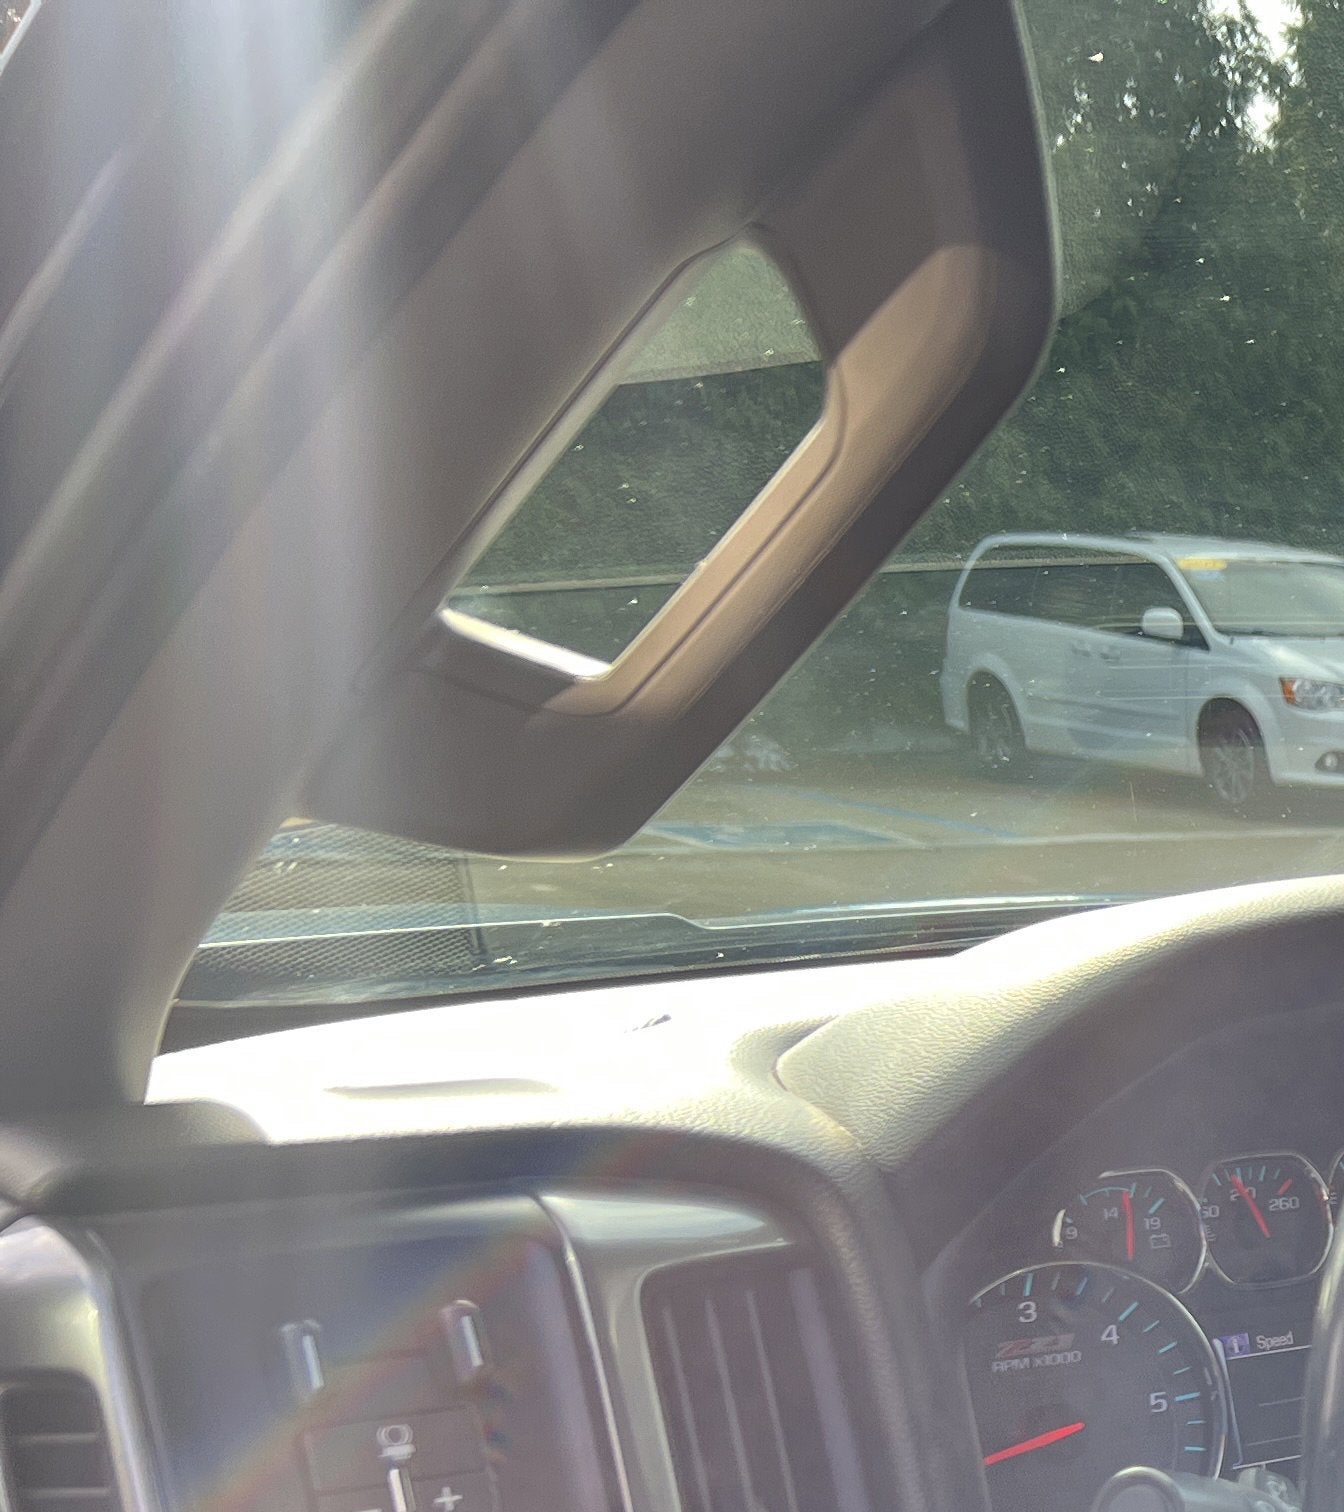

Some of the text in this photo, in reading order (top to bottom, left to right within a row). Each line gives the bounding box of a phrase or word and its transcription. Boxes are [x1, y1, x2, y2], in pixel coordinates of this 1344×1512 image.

[1268, 1197, 1300, 1211] 260
[1102, 1206, 1119, 1220] 14
[1143, 1216, 1162, 1230] 19
[1017, 1301, 1038, 1323] 3
[1100, 1324, 1121, 1345] 4
[1255, 1331, 1294, 1350] Speed
[991, 1357, 1031, 1373] RPM
[1149, 1391, 1169, 1413] 5
